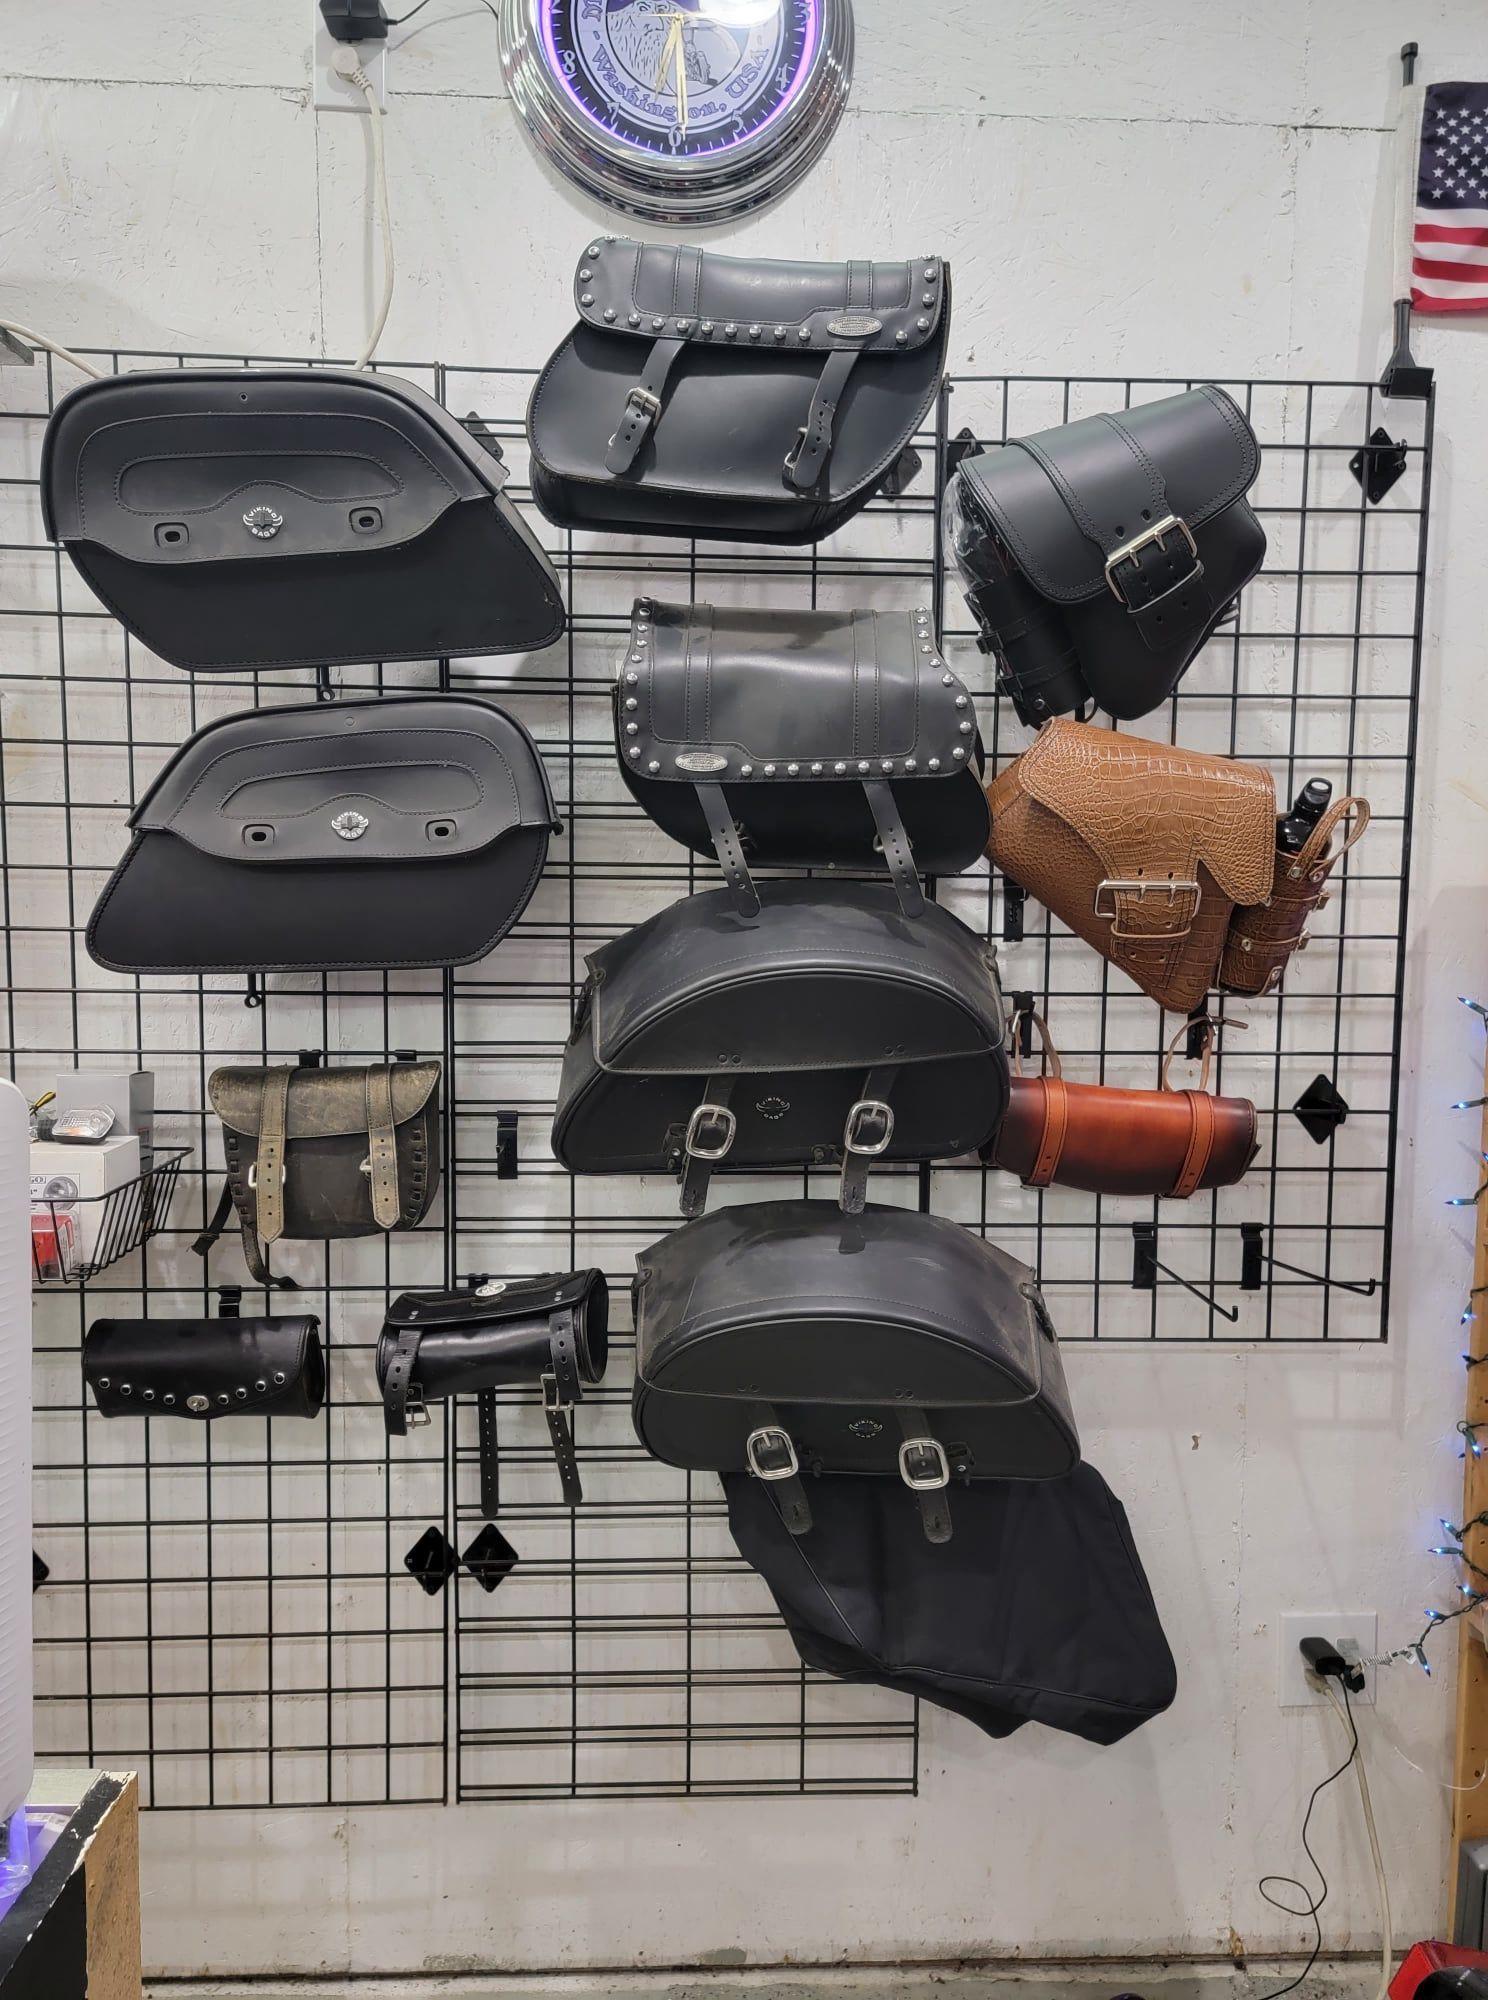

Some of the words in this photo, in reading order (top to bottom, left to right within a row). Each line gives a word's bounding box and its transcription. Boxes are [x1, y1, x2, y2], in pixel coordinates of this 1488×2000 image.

[562, 49, 576, 75] 8
[591, 43, 728, 123] Washingon,
[724, 48, 770, 99] USA
[775, 62, 789, 92] 4
[605, 101, 621, 125] 7
[730, 107, 745, 134] 5
[667, 122, 684, 148] 6
